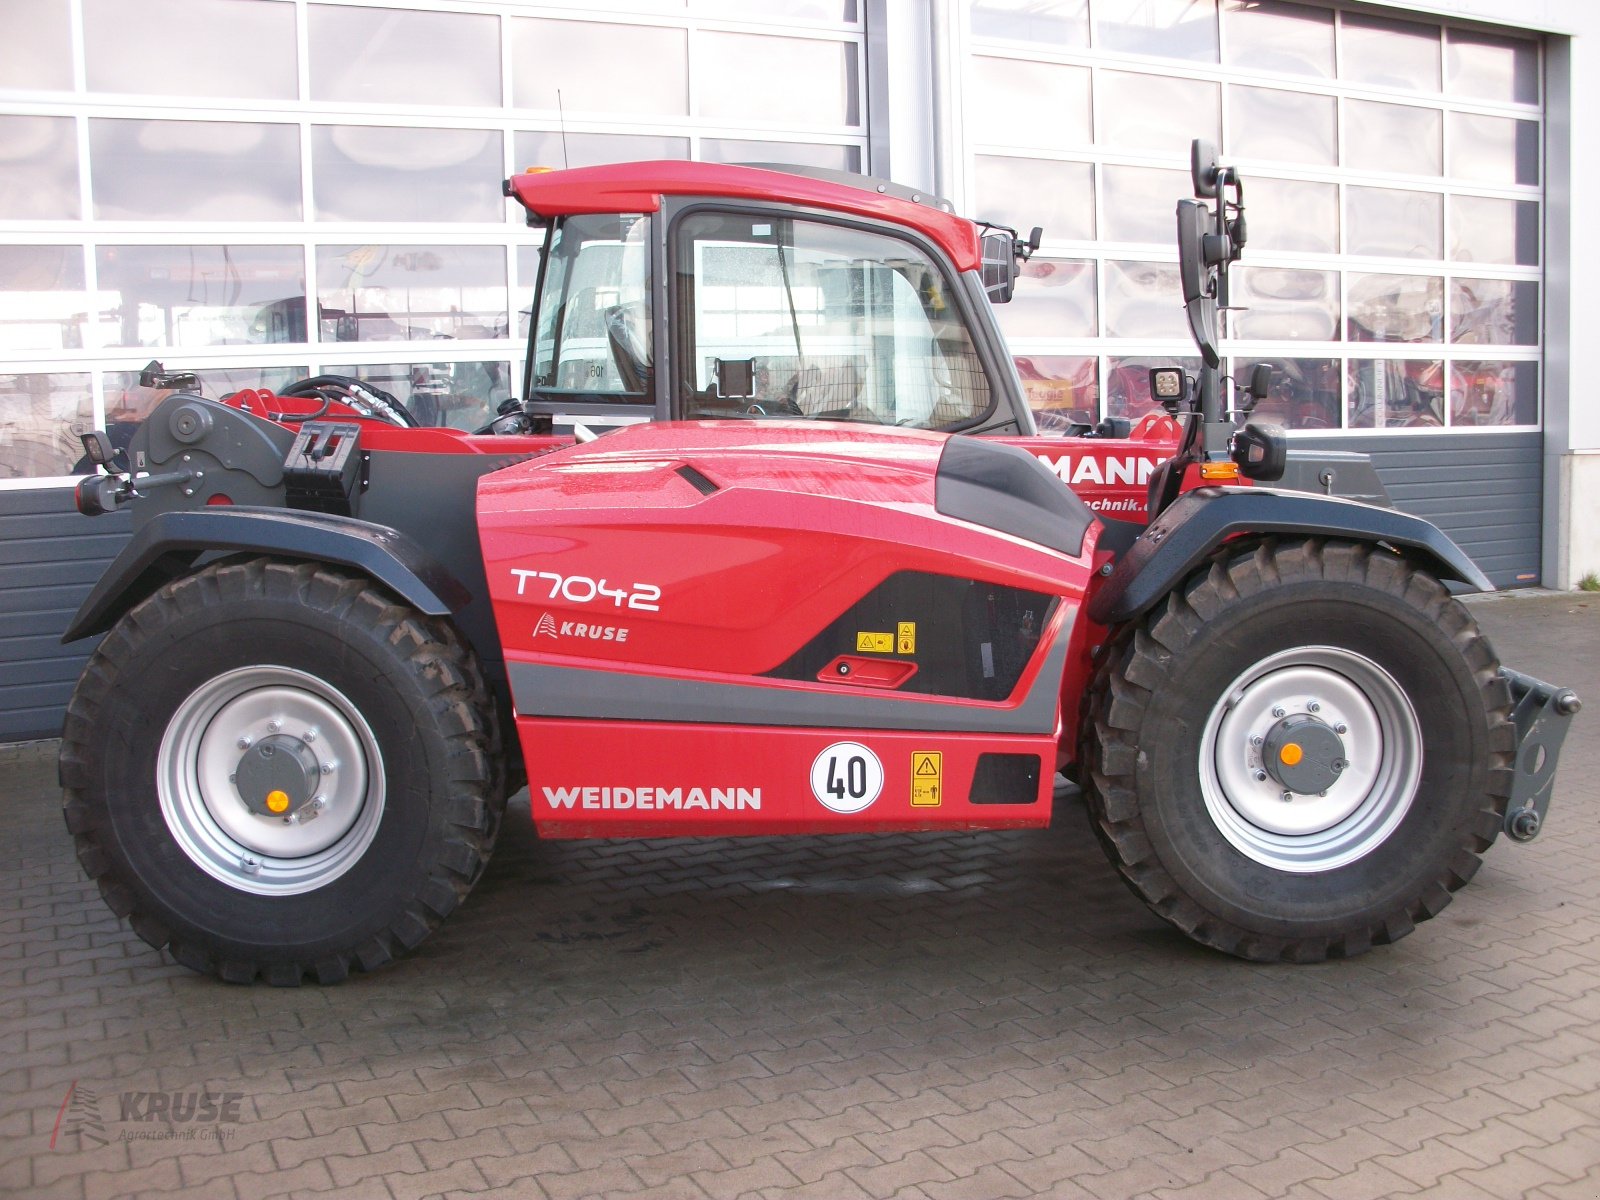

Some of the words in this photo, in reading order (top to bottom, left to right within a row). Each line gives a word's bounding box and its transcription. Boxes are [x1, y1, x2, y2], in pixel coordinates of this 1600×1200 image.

[510, 568, 661, 611] T7042
[560, 621, 629, 642] KRUSE
[827, 756, 866, 799] 40
[542, 786, 761, 810] WEIDEMANN
